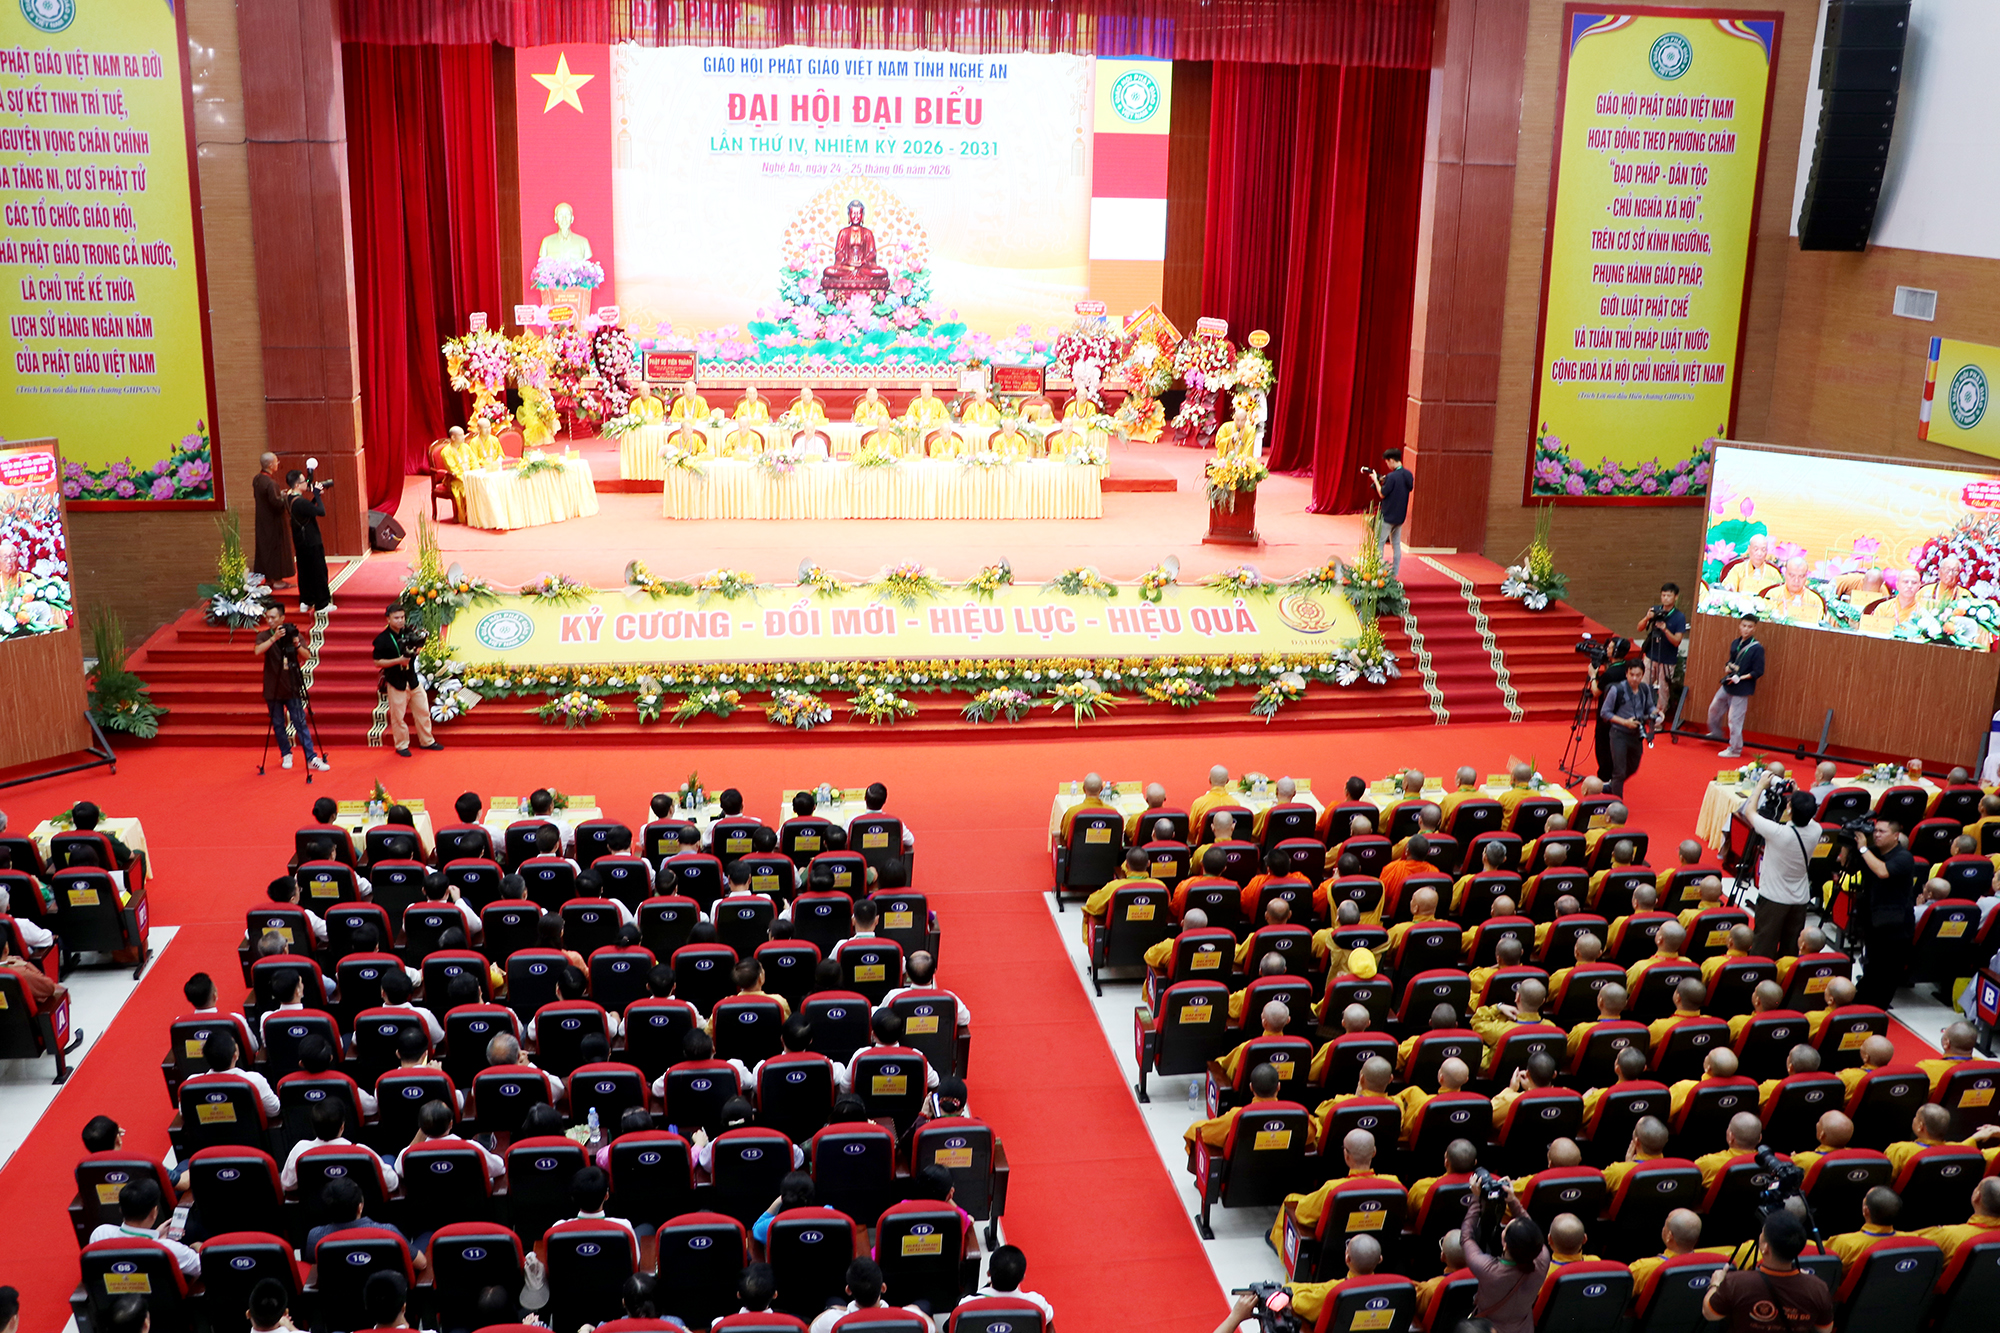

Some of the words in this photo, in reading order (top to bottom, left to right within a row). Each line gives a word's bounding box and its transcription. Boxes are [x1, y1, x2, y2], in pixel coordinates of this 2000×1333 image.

[0, 47, 30, 77] PHẬT
[34, 48, 62, 74] GIÁO
[65, 49, 89, 80] VIỆT
[93, 55, 120, 76] NAM
[124, 56, 139, 76] RA
[142, 50, 161, 77] ĐỜI
[704, 56, 734, 73] GIÁO
[741, 56, 762, 77] HỘI
[769, 57, 802, 79] PHẬT
[809, 57, 839, 75] GIÁO
[845, 57, 872, 80] VIỆT
[878, 61, 908, 76] NAM
[914, 55, 943, 77] TỈNH
[950, 59, 984, 81] NGHỆ
[990, 64, 1007, 79] AN
[728, 93, 777, 127] ĐẠI
[792, 88, 840, 128] HỘI
[853, 96, 901, 130] ĐẠI
[915, 86, 982, 125] BIỂU
[1597, 92, 1619, 114] GIÁO
[1621, 92, 1637, 120] HỘI
[1640, 93, 1664, 120] PHẬT
[1666, 93, 1688, 117] GIÁO
[1691, 95, 1710, 121] VIỆT
[1712, 100, 1734, 118] NAM
[711, 129, 742, 152] LẦN
[750, 133, 783, 152] THỨ
[789, 138, 807, 155] IV,
[815, 135, 868, 158] NHIỆM
[876, 134, 896, 153] KỲ
[904, 140, 943, 154] 2026
[961, 141, 997, 155] 2031
[1588, 130, 1612, 153] HOẠT
[1615, 127, 1640, 153] ĐỘNG
[1643, 131, 1665, 150] THEO
[1668, 131, 1706, 151] PHƯƠNG
[1708, 130, 1735, 152] CHÂM
[929, 164, 951, 175] 2026
[1635, 163, 1660, 184] PHÁP
[1669, 162, 1688, 185] DÂN
[1691, 163, 1708, 189] TỘC
[6, 201, 29, 226] CÁC
[32, 198, 46, 226] TỔ
[50, 203, 80, 227] CHỨC
[83, 203, 110, 227] GIÁO
[113, 203, 136, 232] HỘI,
[1613, 192, 1632, 216] CHỦ
[1634, 196, 1662, 217] NGHĨA
[1665, 196, 1677, 218] XÃ
[1592, 228, 1615, 249] TRÊN
[1617, 231, 1631, 250] CƠ
[1632, 225, 1645, 250] SỞ
[1647, 229, 1669, 251] KÍNH
[1671, 229, 1711, 254] NGƯỠNG,
[22, 276, 36, 300] LÀ
[39, 274, 62, 300] CHỦ
[64, 273, 86, 301] THỂ
[88, 275, 103, 301] KẾ
[106, 277, 135, 301] THỪA
[1593, 265, 1624, 287] PHỤNG
[1627, 262, 1652, 283] HÀNH
[1654, 263, 1676, 284] GIÁO
[1678, 264, 1702, 286] PHÁP,
[1601, 294, 1619, 315] GIỚI
[1621, 295, 1644, 320] LUẬT
[1645, 295, 1669, 321] PHẬT
[1671, 293, 1689, 317] CHẾ
[11, 317, 37, 341] LỊCH
[40, 310, 55, 337] SỬ
[58, 313, 89, 337] HÀNG
[92, 313, 123, 337] NGÀN
[126, 314, 152, 337] NĂM
[1575, 325, 1585, 348] VÀ
[1590, 327, 1613, 348] TUÂN
[1616, 325, 1632, 349] THỦ
[1634, 328, 1658, 349] PHÁP
[1661, 328, 1683, 354] LUẬT
[1684, 329, 1709, 350] NƯỚC
[17, 346, 40, 372] CỦA
[42, 349, 70, 377] PHẬT
[74, 349, 100, 373] GIÁO
[102, 349, 125, 377] VIỆT
[129, 354, 155, 373] NAM
[1552, 358, 1577, 385] CỘNG
[1579, 359, 1597, 380] HOÀ
[1600, 359, 1611, 380] XÃ
[1615, 360, 1630, 385] HỘI
[1633, 358, 1651, 381] CHỦ
[1653, 361, 1679, 381] NGHĨA
[1683, 361, 1702, 386] VIỆT
[1703, 365, 1724, 382] NAM
[562, 607, 603, 642] KỶ
[616, 611, 729, 640] CƯƠNG
[765, 600, 819, 636] ĐỔI
[833, 603, 895, 634] MỚI
[930, 603, 1003, 639] HIỆU
[1015, 606, 1075, 640] LỰC
[1108, 603, 1181, 639] HIỆU
[1191, 600, 1256, 635] QUẢ
[1984, 985, 1995, 1006] B
[58, 1008, 66, 1031] A
[1901, 1261, 1911, 1269] 21
